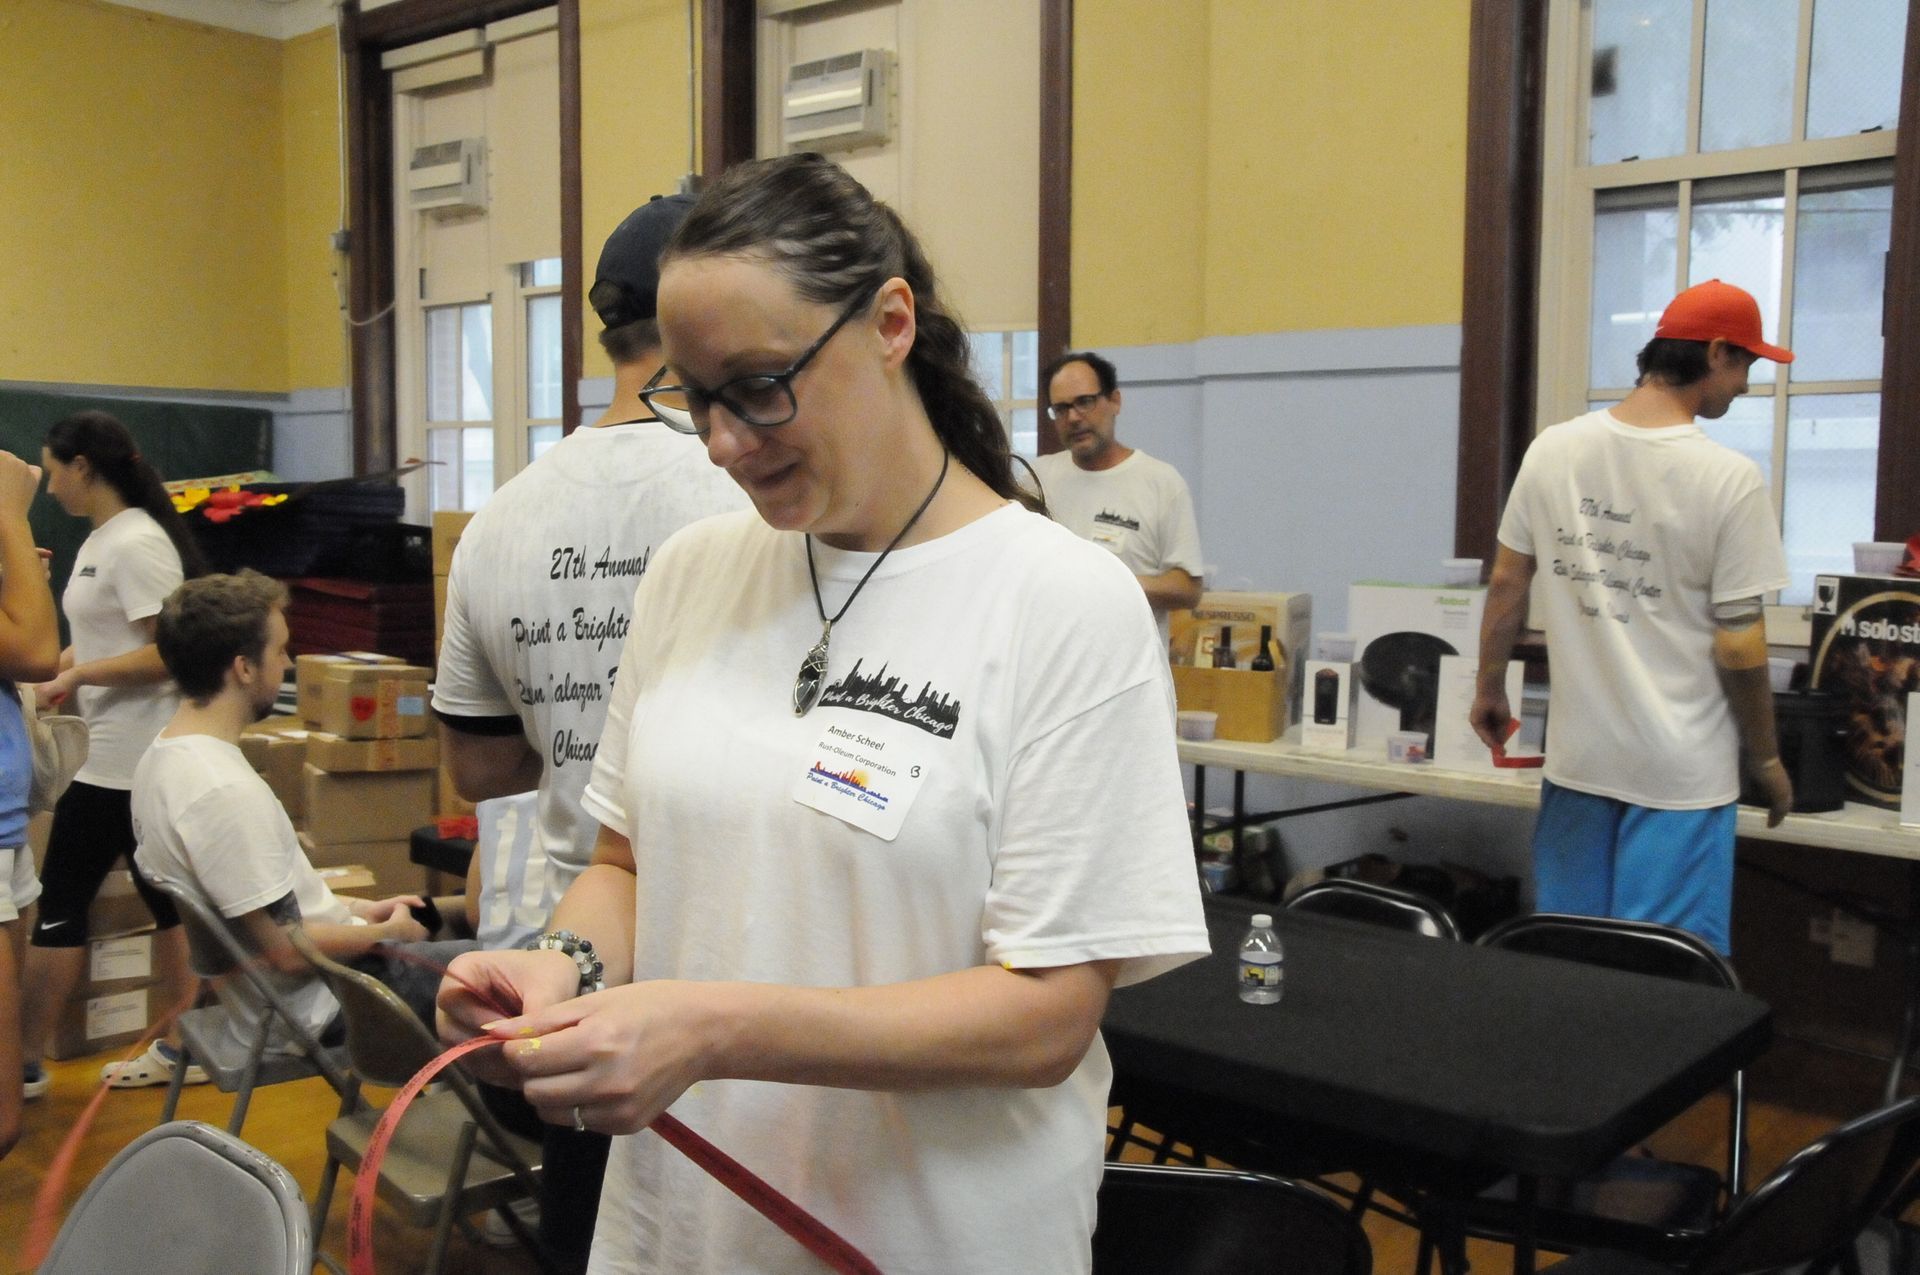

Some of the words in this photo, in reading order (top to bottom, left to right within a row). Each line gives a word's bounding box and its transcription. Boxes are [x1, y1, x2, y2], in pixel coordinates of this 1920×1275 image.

[549, 545, 587, 580] 27th
[590, 545, 650, 580] Annual
[556, 621, 568, 642] a
[572, 606, 631, 652] Brighte
[1859, 617, 1899, 641] solo
[549, 672, 603, 712] alazar
[855, 692, 902, 714] Brighter
[903, 705, 954, 734] Chicago
[552, 729, 600, 768] Chica
[828, 724, 856, 741] Amber
[855, 734, 886, 752] Scheel
[818, 741, 855, 760] Rust-Oleum
[854, 754, 898, 777] Corporation
[856, 793, 887, 811] Chicago
